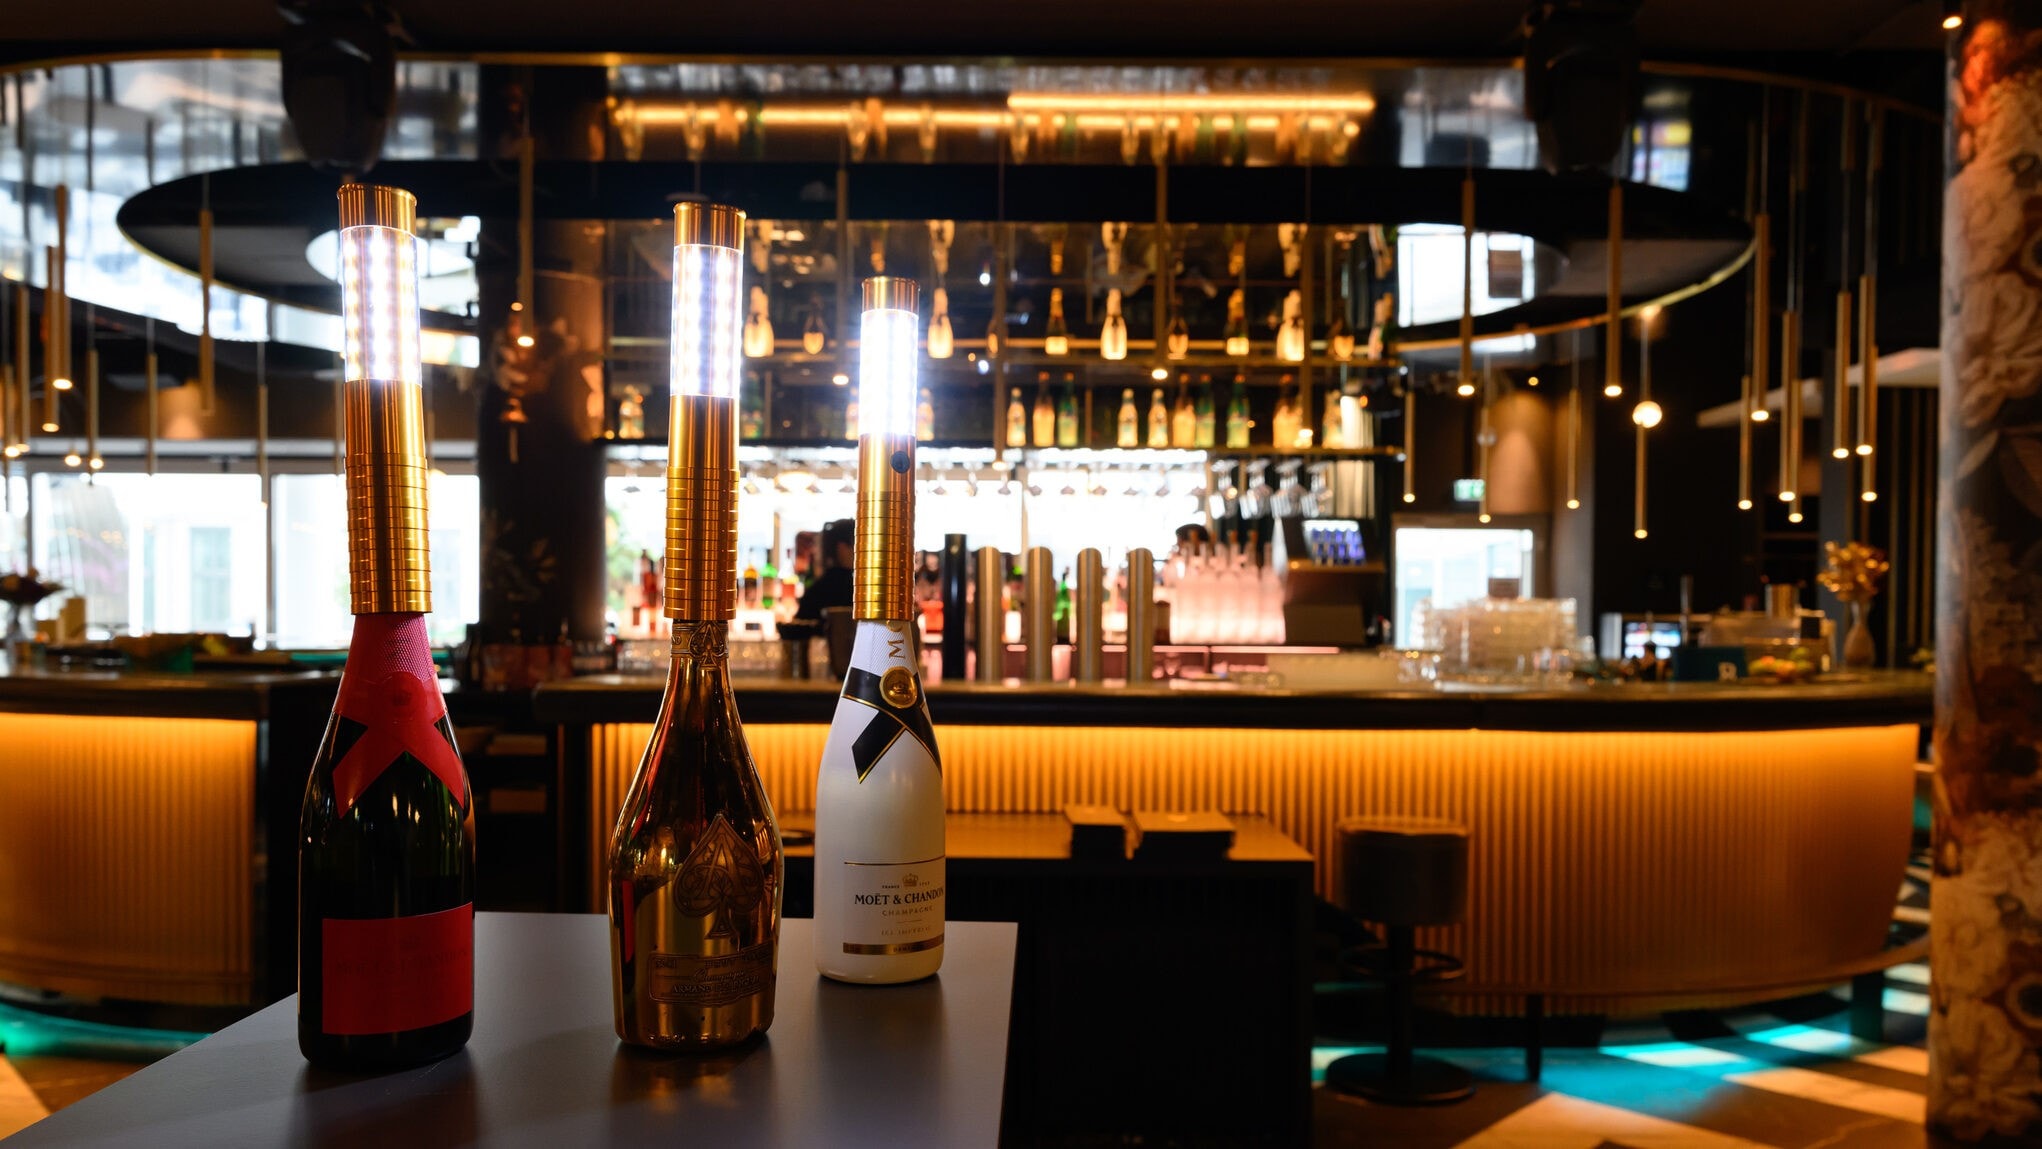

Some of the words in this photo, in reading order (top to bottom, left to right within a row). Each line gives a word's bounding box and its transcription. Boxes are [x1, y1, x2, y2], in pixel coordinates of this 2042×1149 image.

[854, 893, 890, 905] MOËT
[892, 894, 902, 905] &
[904, 887, 944, 904] CHANDON
[881, 905, 934, 916] CHAMPAGNE
